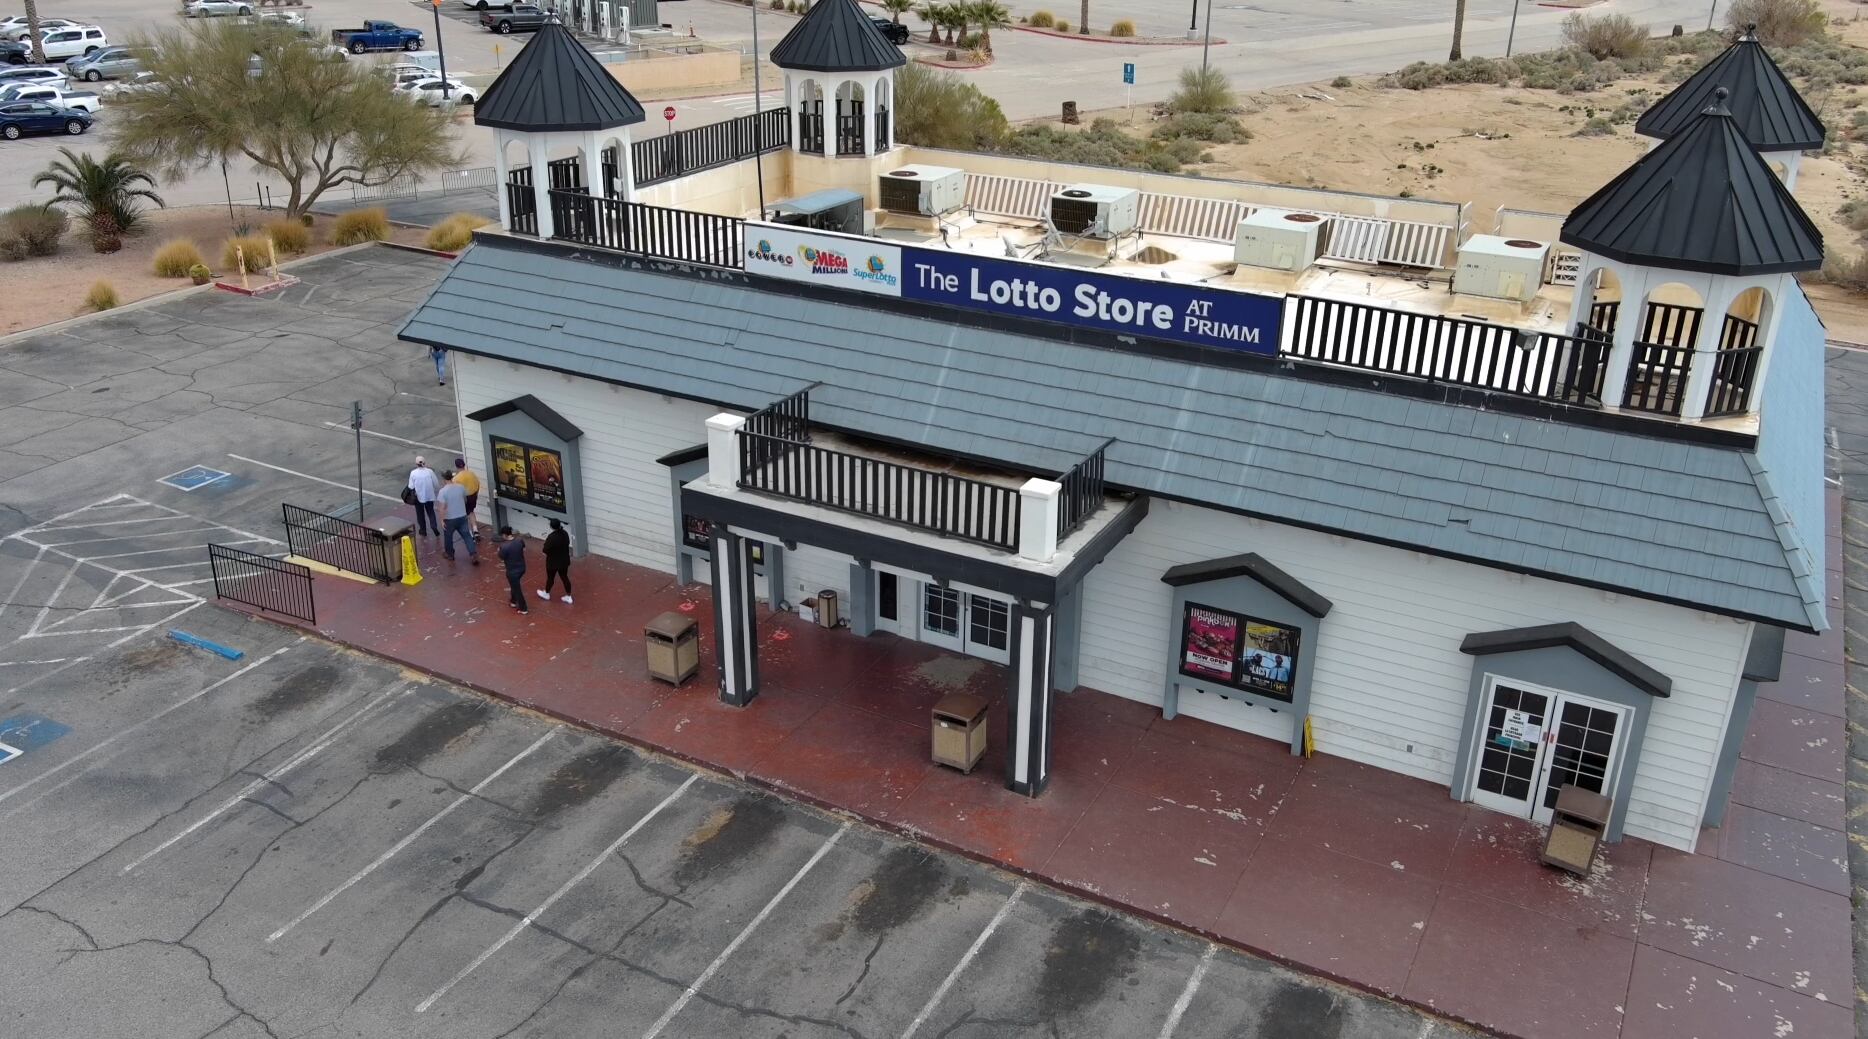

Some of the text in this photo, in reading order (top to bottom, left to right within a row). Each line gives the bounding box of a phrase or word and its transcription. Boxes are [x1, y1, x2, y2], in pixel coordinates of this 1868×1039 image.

[814, 250, 848, 268] MEGA
[812, 265, 848, 274] MILLIONS
[853, 268, 896, 282] SuperLotto
[915, 263, 1173, 330] The Lotto Store
[1186, 299, 1212, 315] AT
[1183, 317, 1260, 344] PRIMM
[1193, 653, 1209, 661] NOW
[1210, 656, 1228, 665] OPEN
